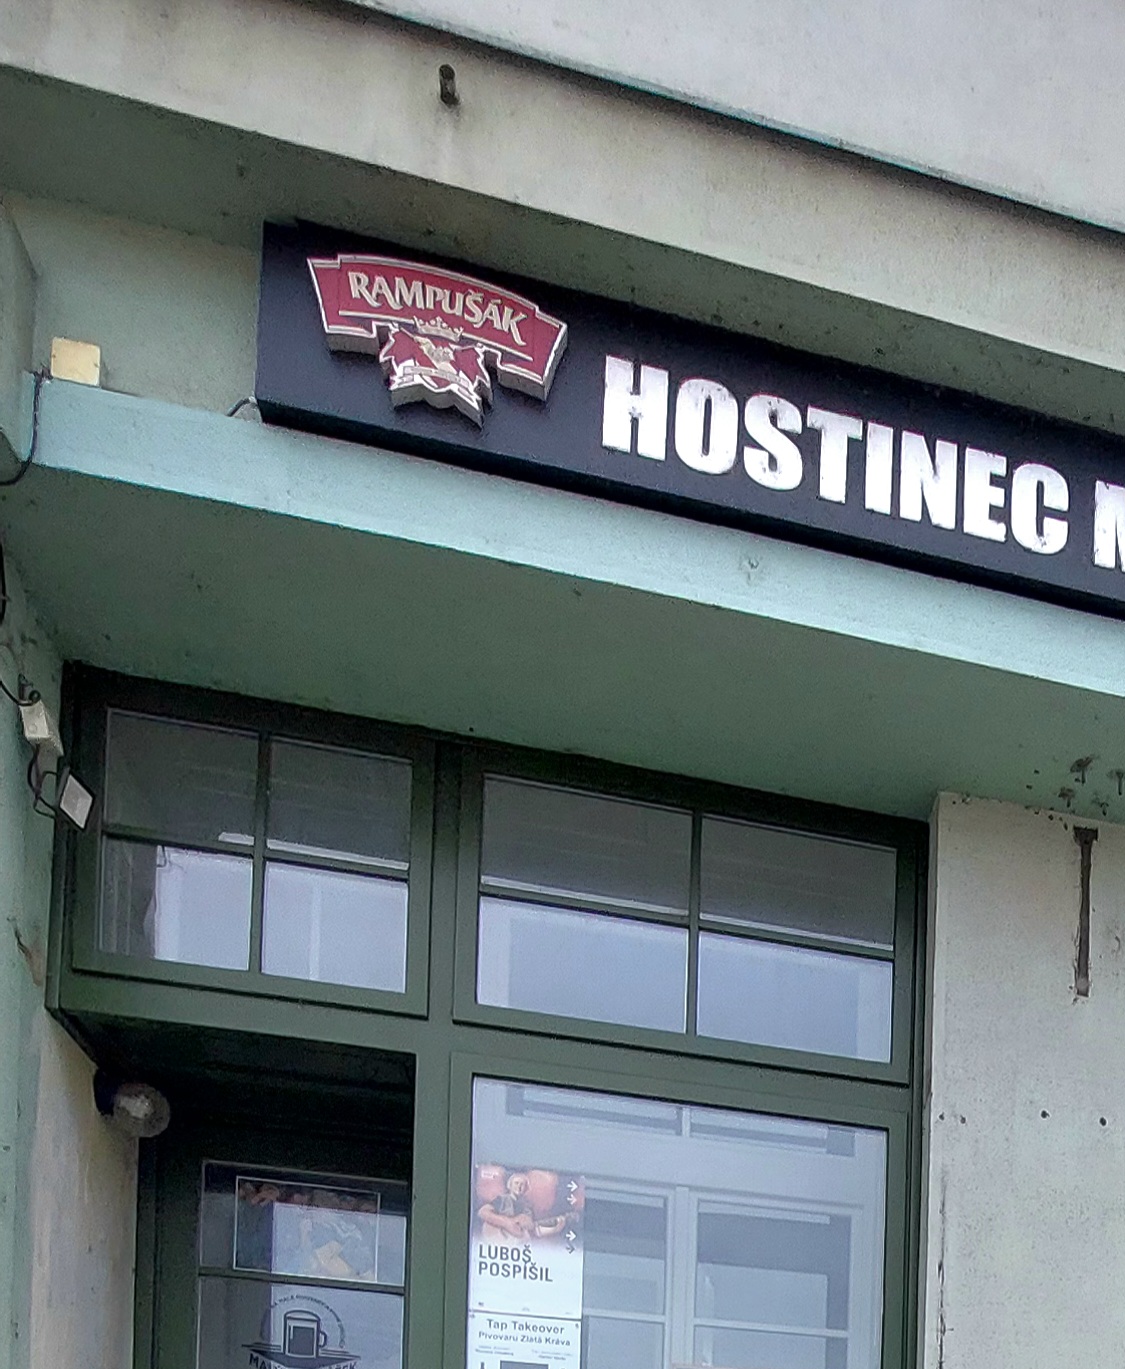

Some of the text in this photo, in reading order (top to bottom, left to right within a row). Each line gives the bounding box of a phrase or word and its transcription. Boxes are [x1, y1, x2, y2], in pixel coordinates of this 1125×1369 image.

[348, 270, 527, 346] RAMPUŠÁK
[602, 354, 1069, 555] HOSTINEC
[479, 1243, 532, 1263] LUBOŠ
[478, 1261, 553, 1282] POSPÍŠIL
[486, 1318, 564, 1334] Tap Takeover
[478, 1331, 518, 1342] Pivovaru
